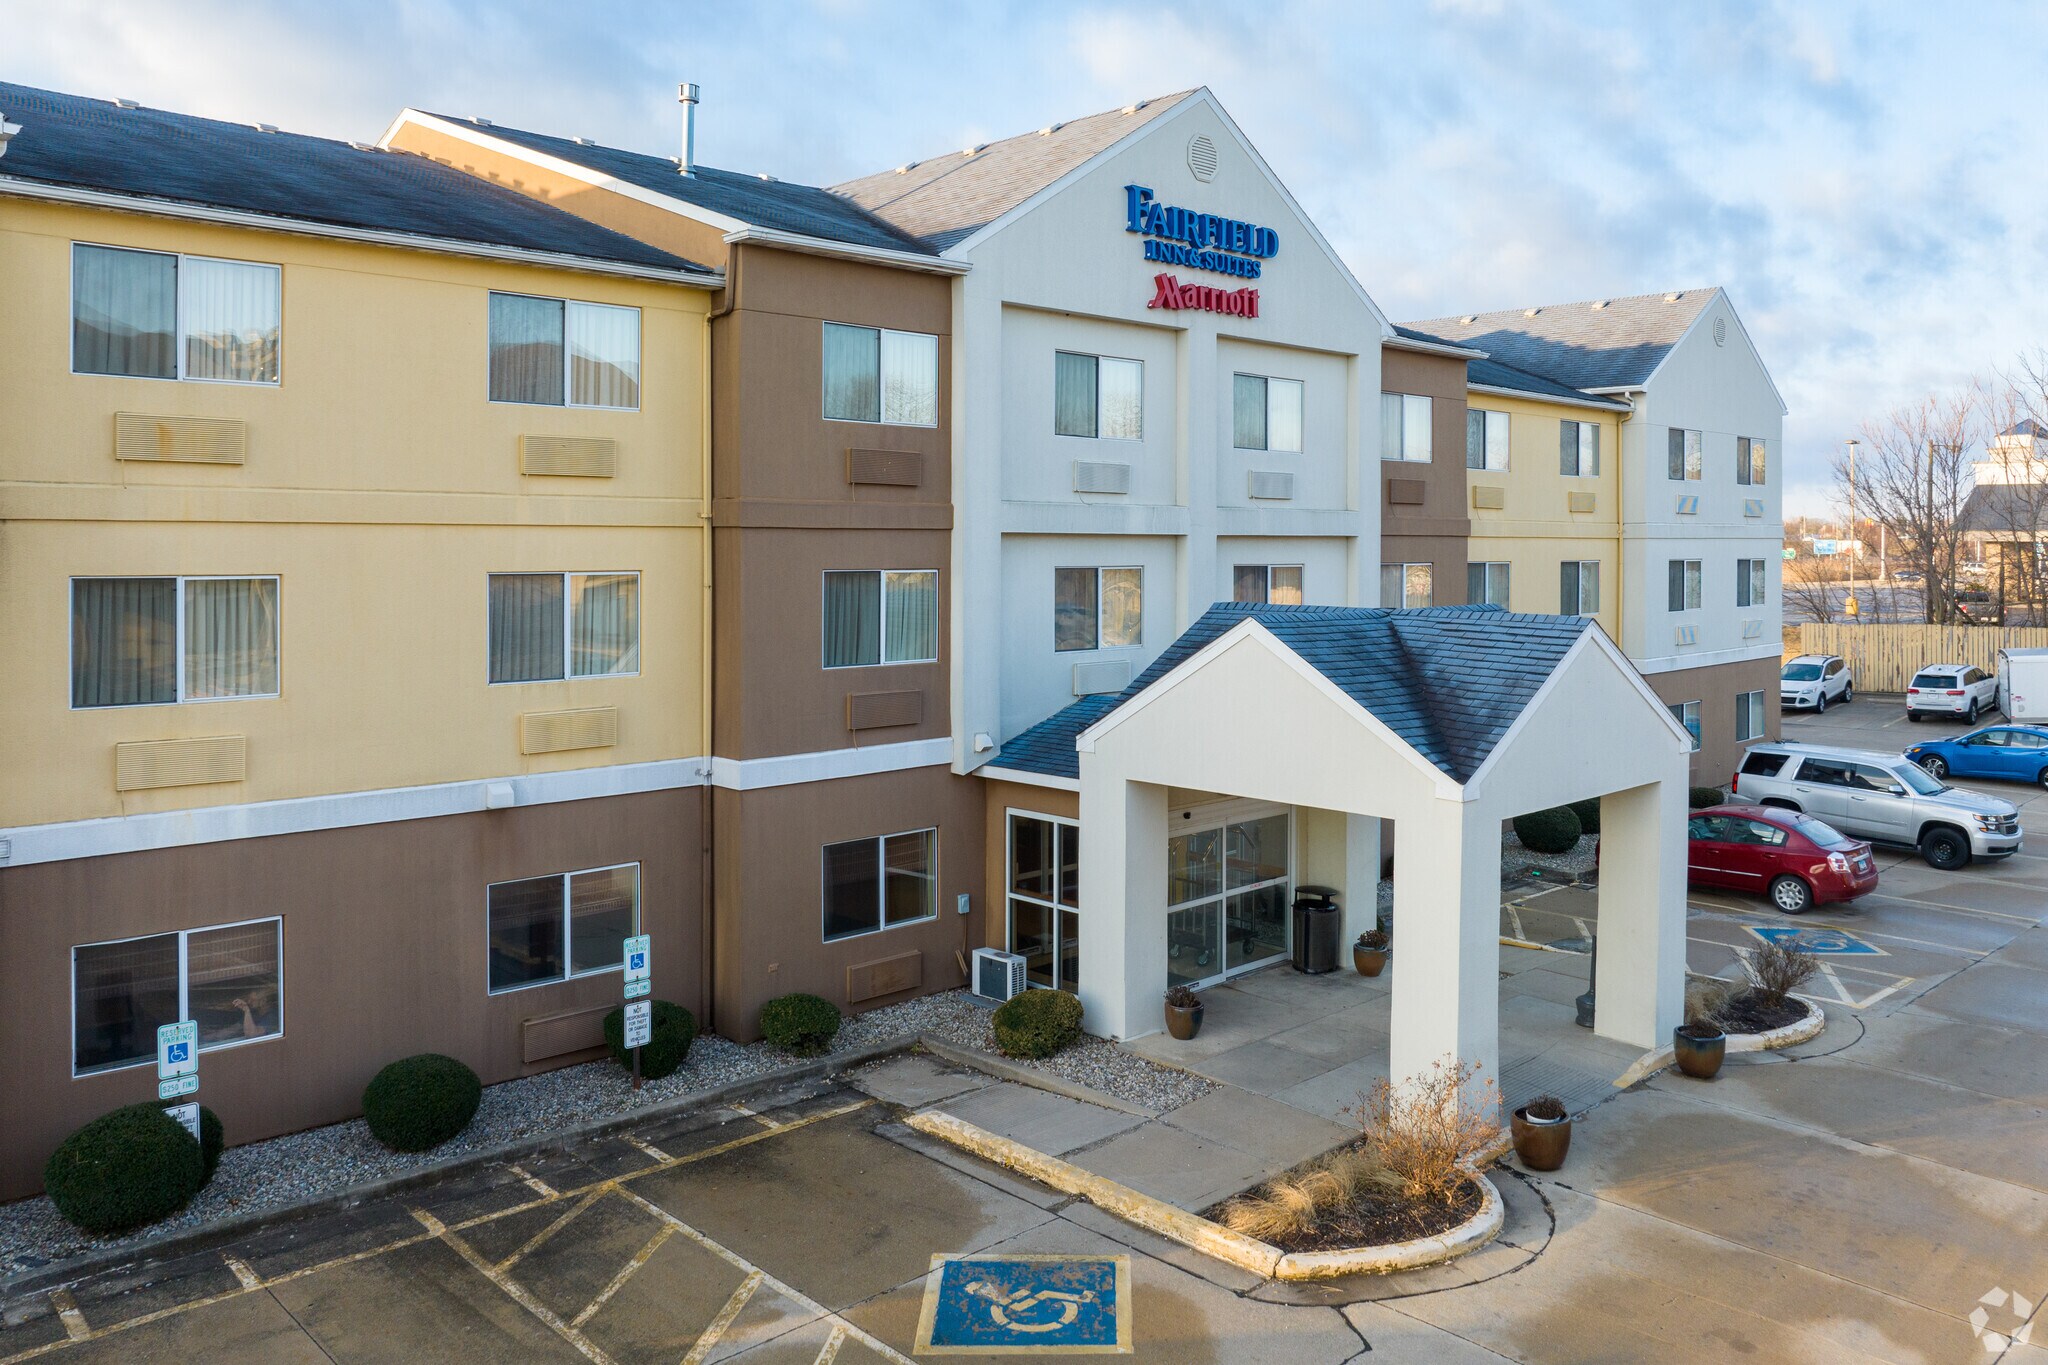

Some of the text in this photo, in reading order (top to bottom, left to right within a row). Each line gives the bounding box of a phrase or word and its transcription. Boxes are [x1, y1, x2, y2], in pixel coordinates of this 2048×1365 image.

[1124, 184, 1279, 259] FAIRFIELD
[1143, 239, 1187, 265] INN
[1201, 250, 1262, 279] SUITES
[1147, 273, 1260, 318] Marriott
[627, 945, 647, 953] PARKING
[626, 985, 638, 995] $250
[626, 1012, 649, 1021] RESPONSIBLE
[160, 1025, 194, 1038] RESERVED
[163, 1034, 193, 1044] PARKING
[630, 1035, 646, 1043] VEHICLES
[162, 1080, 196, 1094] $250 FINE
